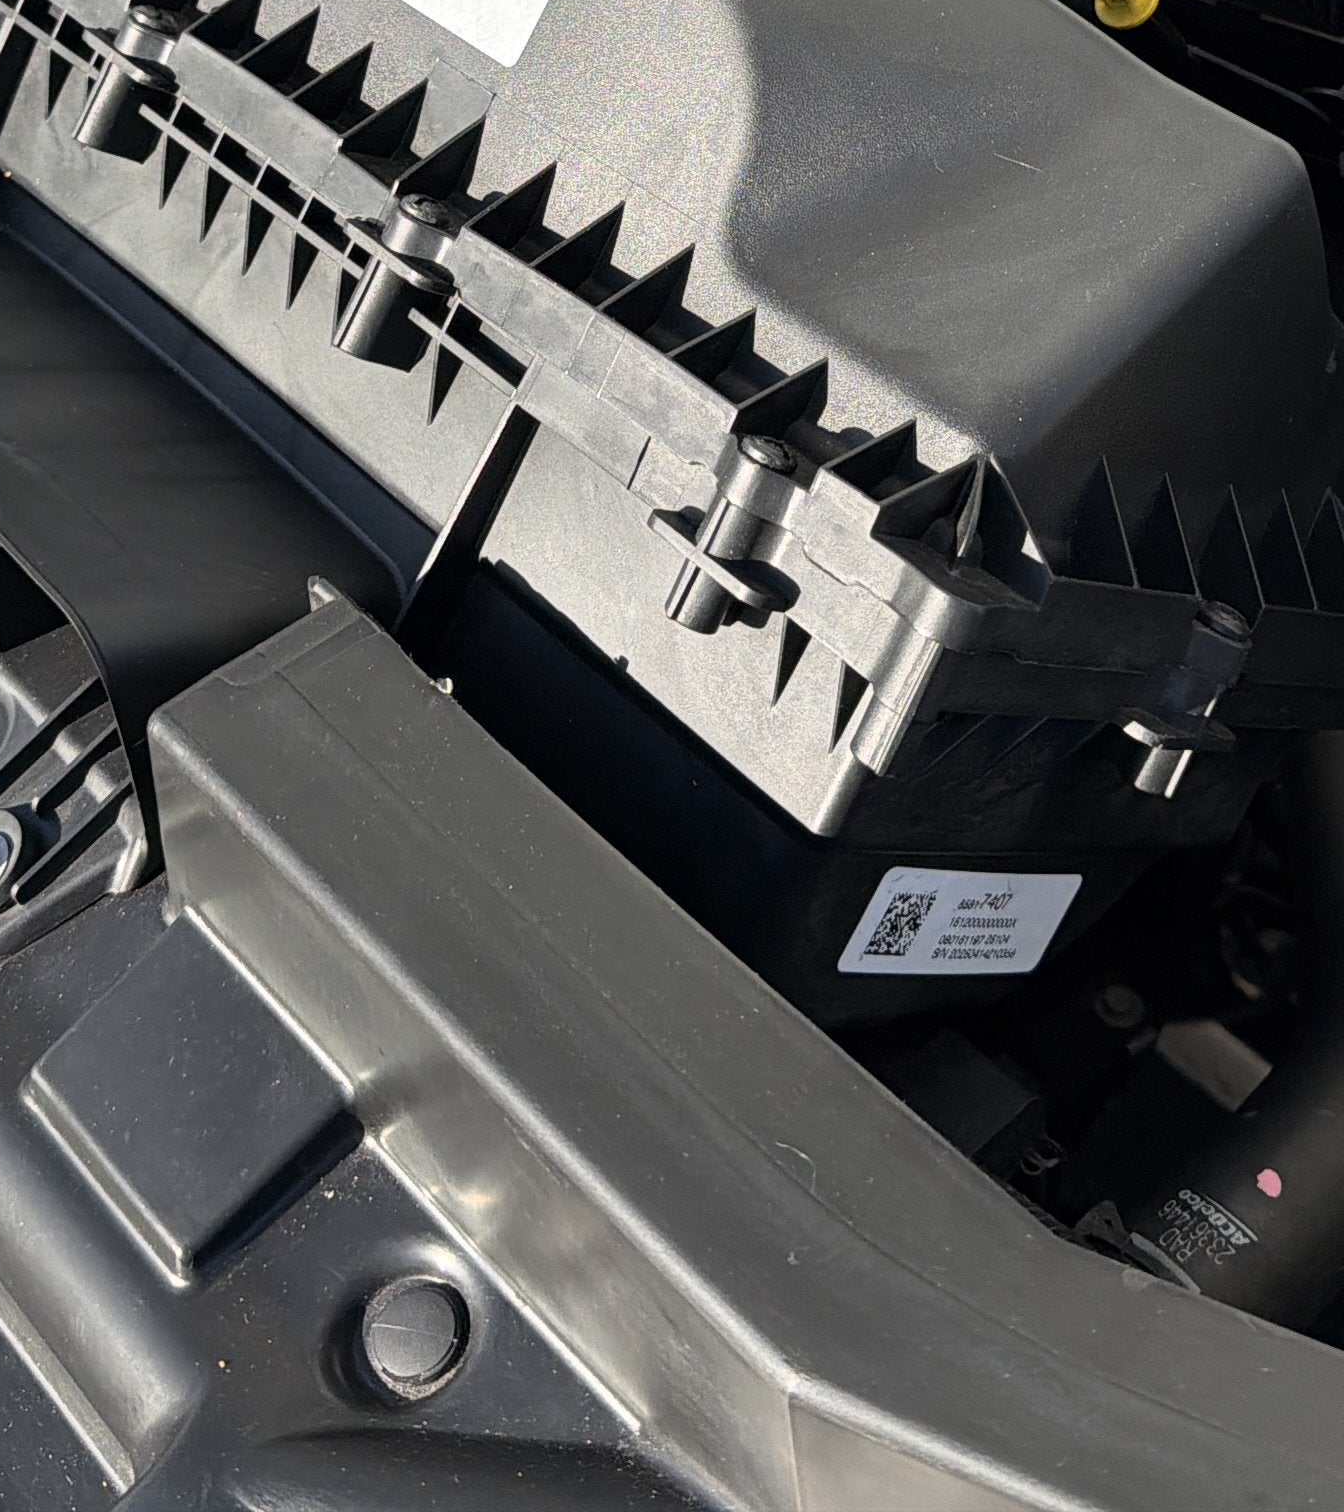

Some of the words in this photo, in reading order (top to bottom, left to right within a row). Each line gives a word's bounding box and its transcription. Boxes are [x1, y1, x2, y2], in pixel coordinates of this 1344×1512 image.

[1158, 1200, 1235, 1264] 23361446
[1179, 1189, 1250, 1245] ACDelco
[1159, 1228, 1198, 1263] RAD
